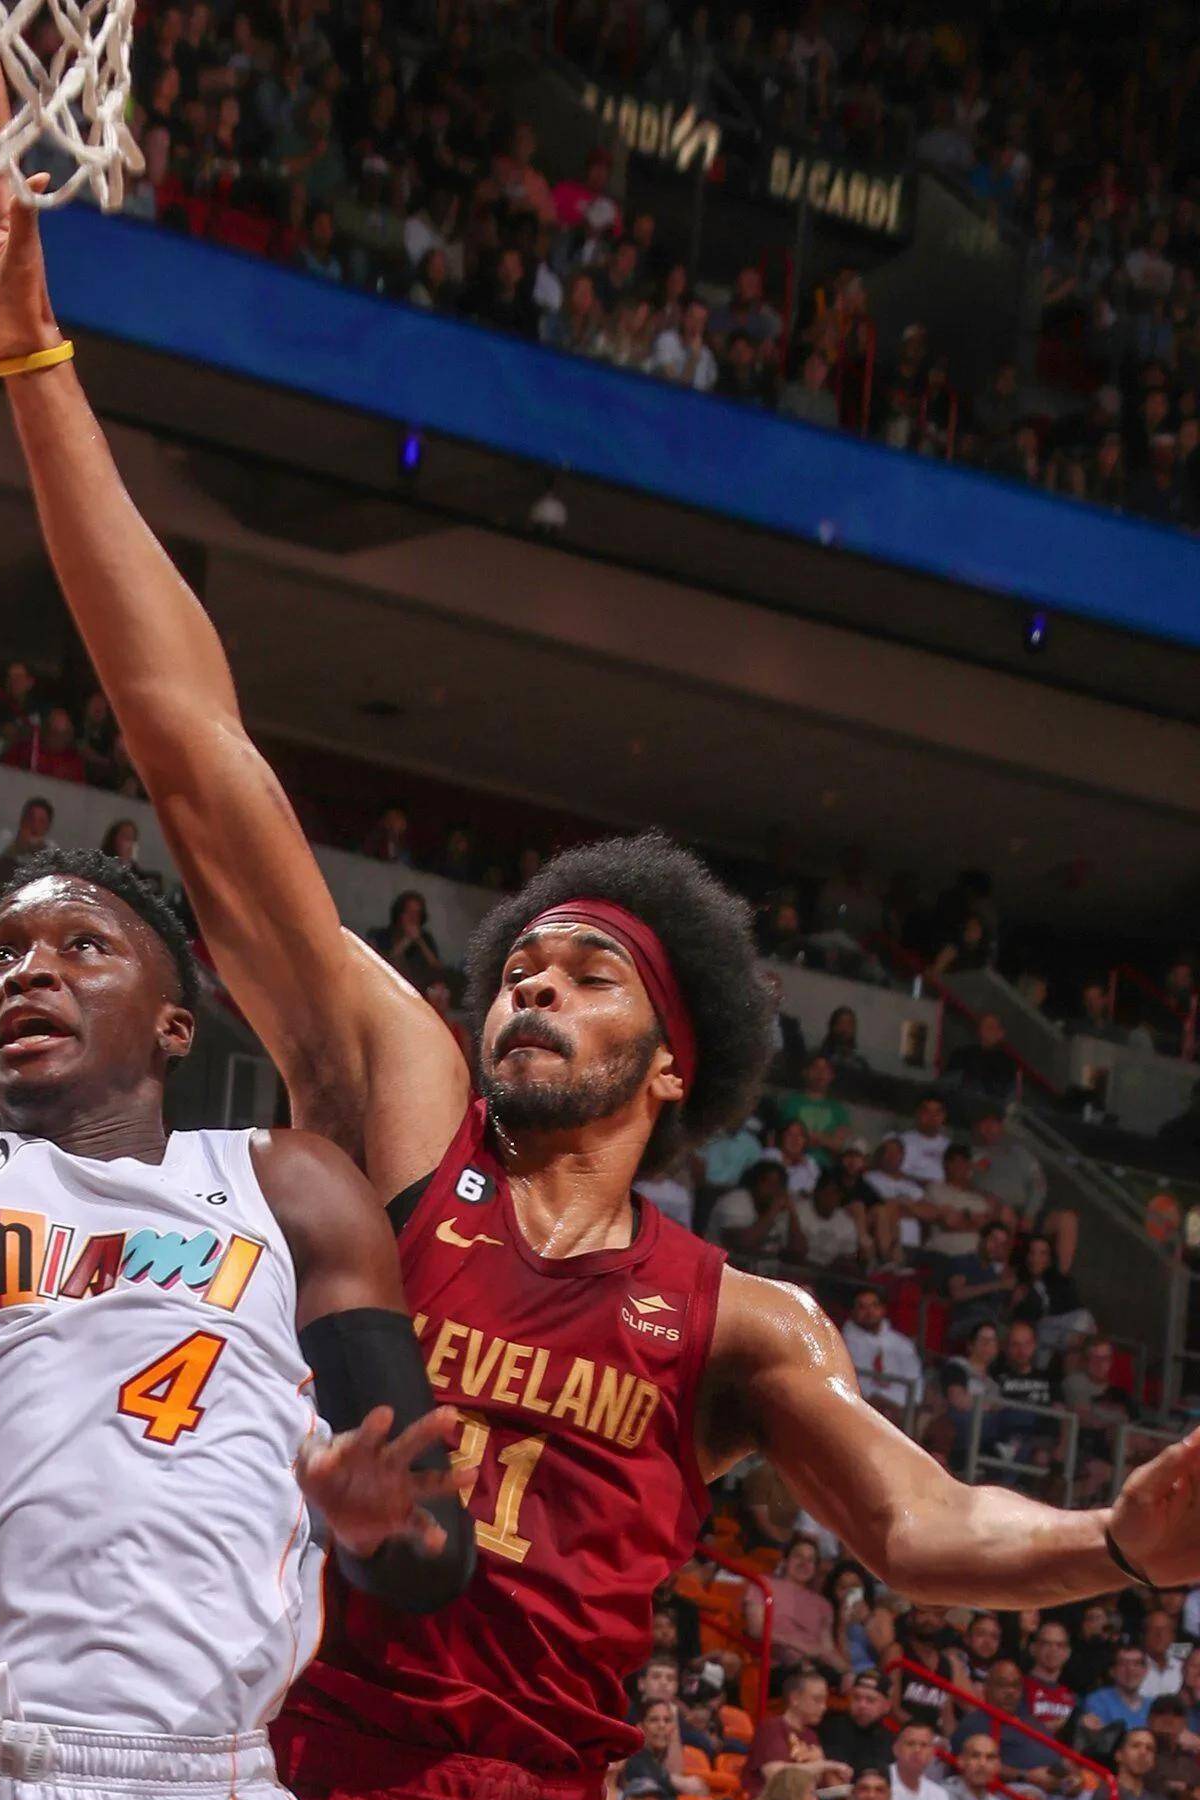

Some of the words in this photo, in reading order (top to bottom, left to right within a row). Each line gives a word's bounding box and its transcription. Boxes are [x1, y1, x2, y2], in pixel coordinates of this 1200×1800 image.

[455, 1168, 486, 1202] 6
[620, 1307, 680, 1343] CLIFFS
[117, 1329, 228, 1446] 4
